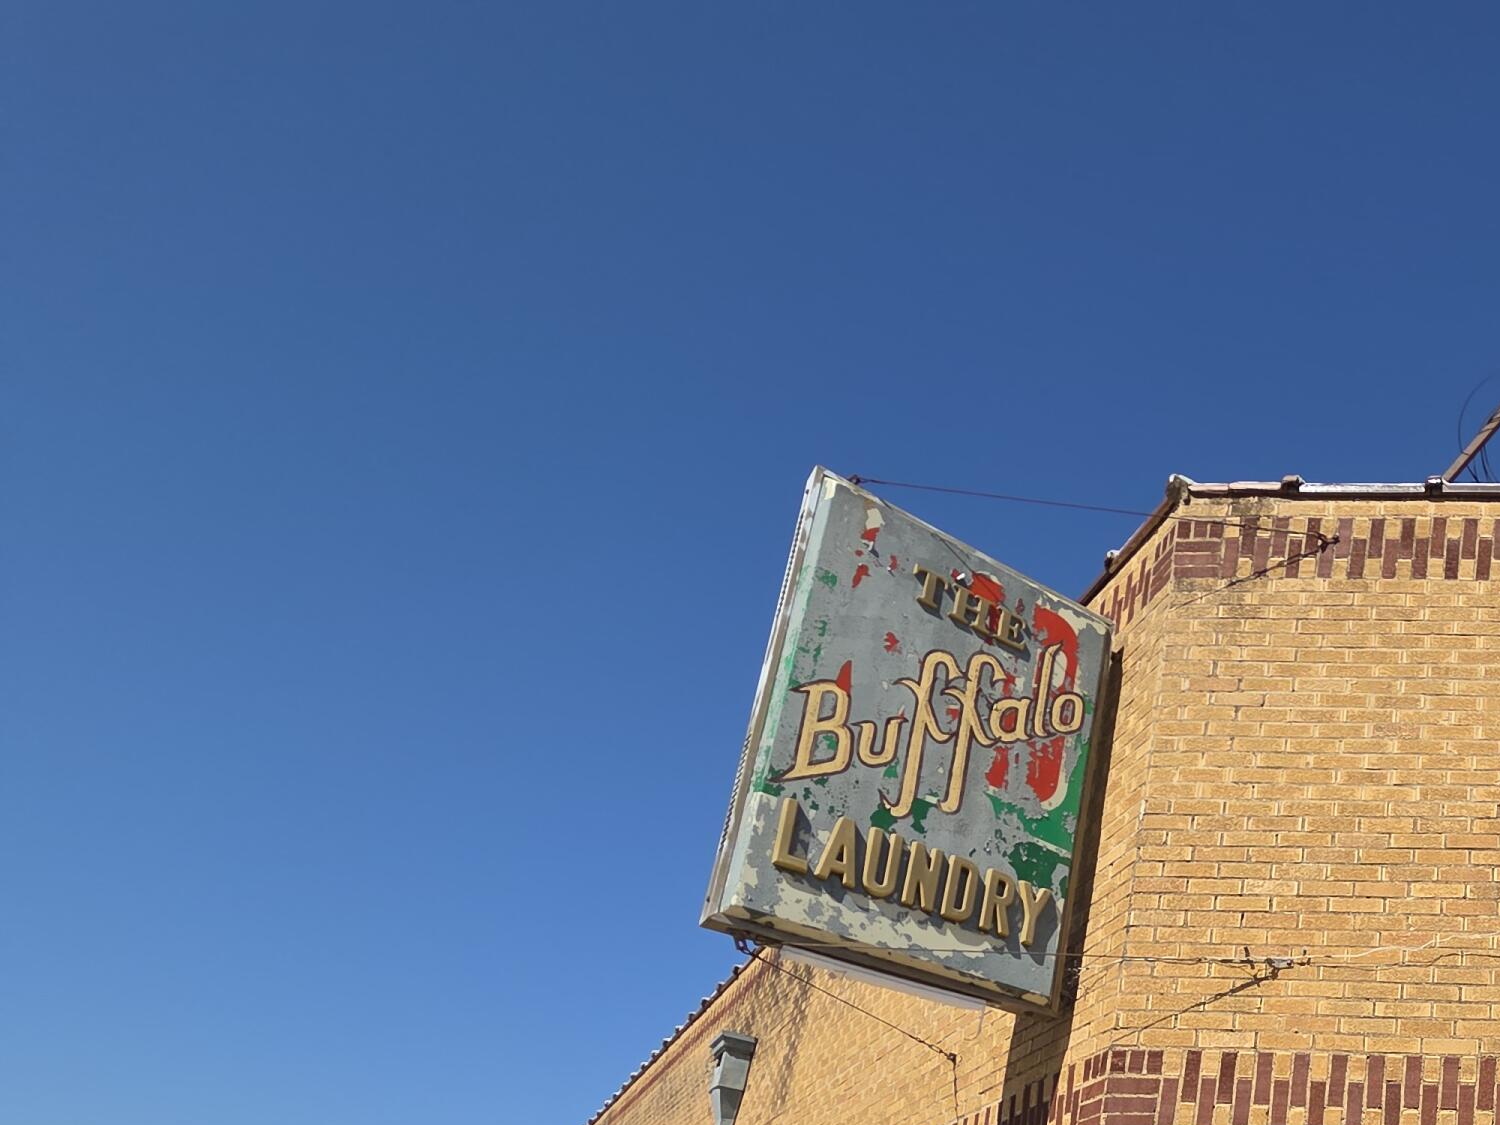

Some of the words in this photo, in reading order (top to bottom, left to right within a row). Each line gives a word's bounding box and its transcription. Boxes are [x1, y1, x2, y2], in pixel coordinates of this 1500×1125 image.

[913, 563, 1031, 651] THE
[766, 643, 1084, 818] Buffalo
[772, 796, 1053, 947] LAUNDRY
